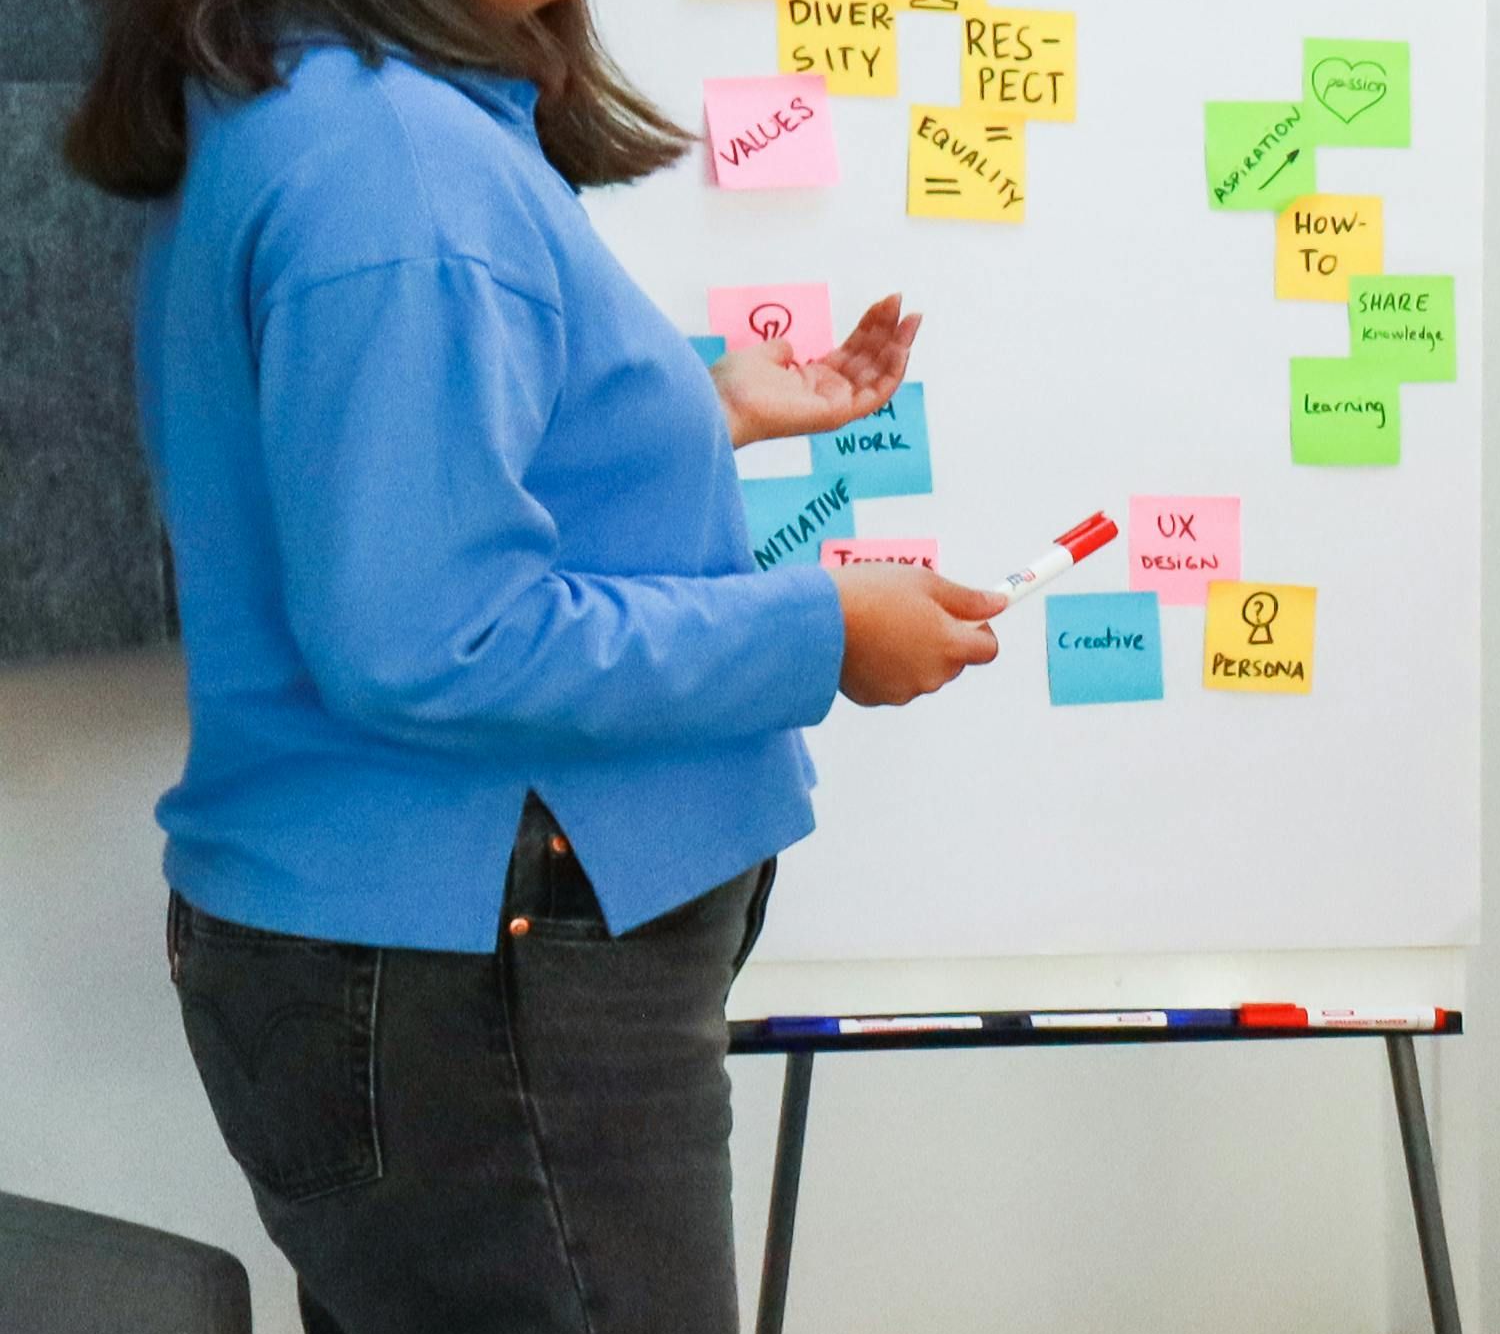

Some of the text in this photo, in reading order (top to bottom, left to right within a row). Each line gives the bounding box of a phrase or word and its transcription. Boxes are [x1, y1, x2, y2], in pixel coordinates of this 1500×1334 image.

[965, 18, 1062, 61] RES-
[792, 46, 881, 78] SITY
[979, 67, 1064, 104] PECT
[719, 96, 815, 167] VALUES
[916, 115, 1024, 210] EQUALITY
[1298, 248, 1338, 276] TO
[1358, 292, 1430, 313] SHARE
[835, 433, 911, 455] WORK
[1157, 514, 1197, 542] UX
[1058, 625, 1145, 651] Creative
[1212, 652, 1304, 681] PERSONA
